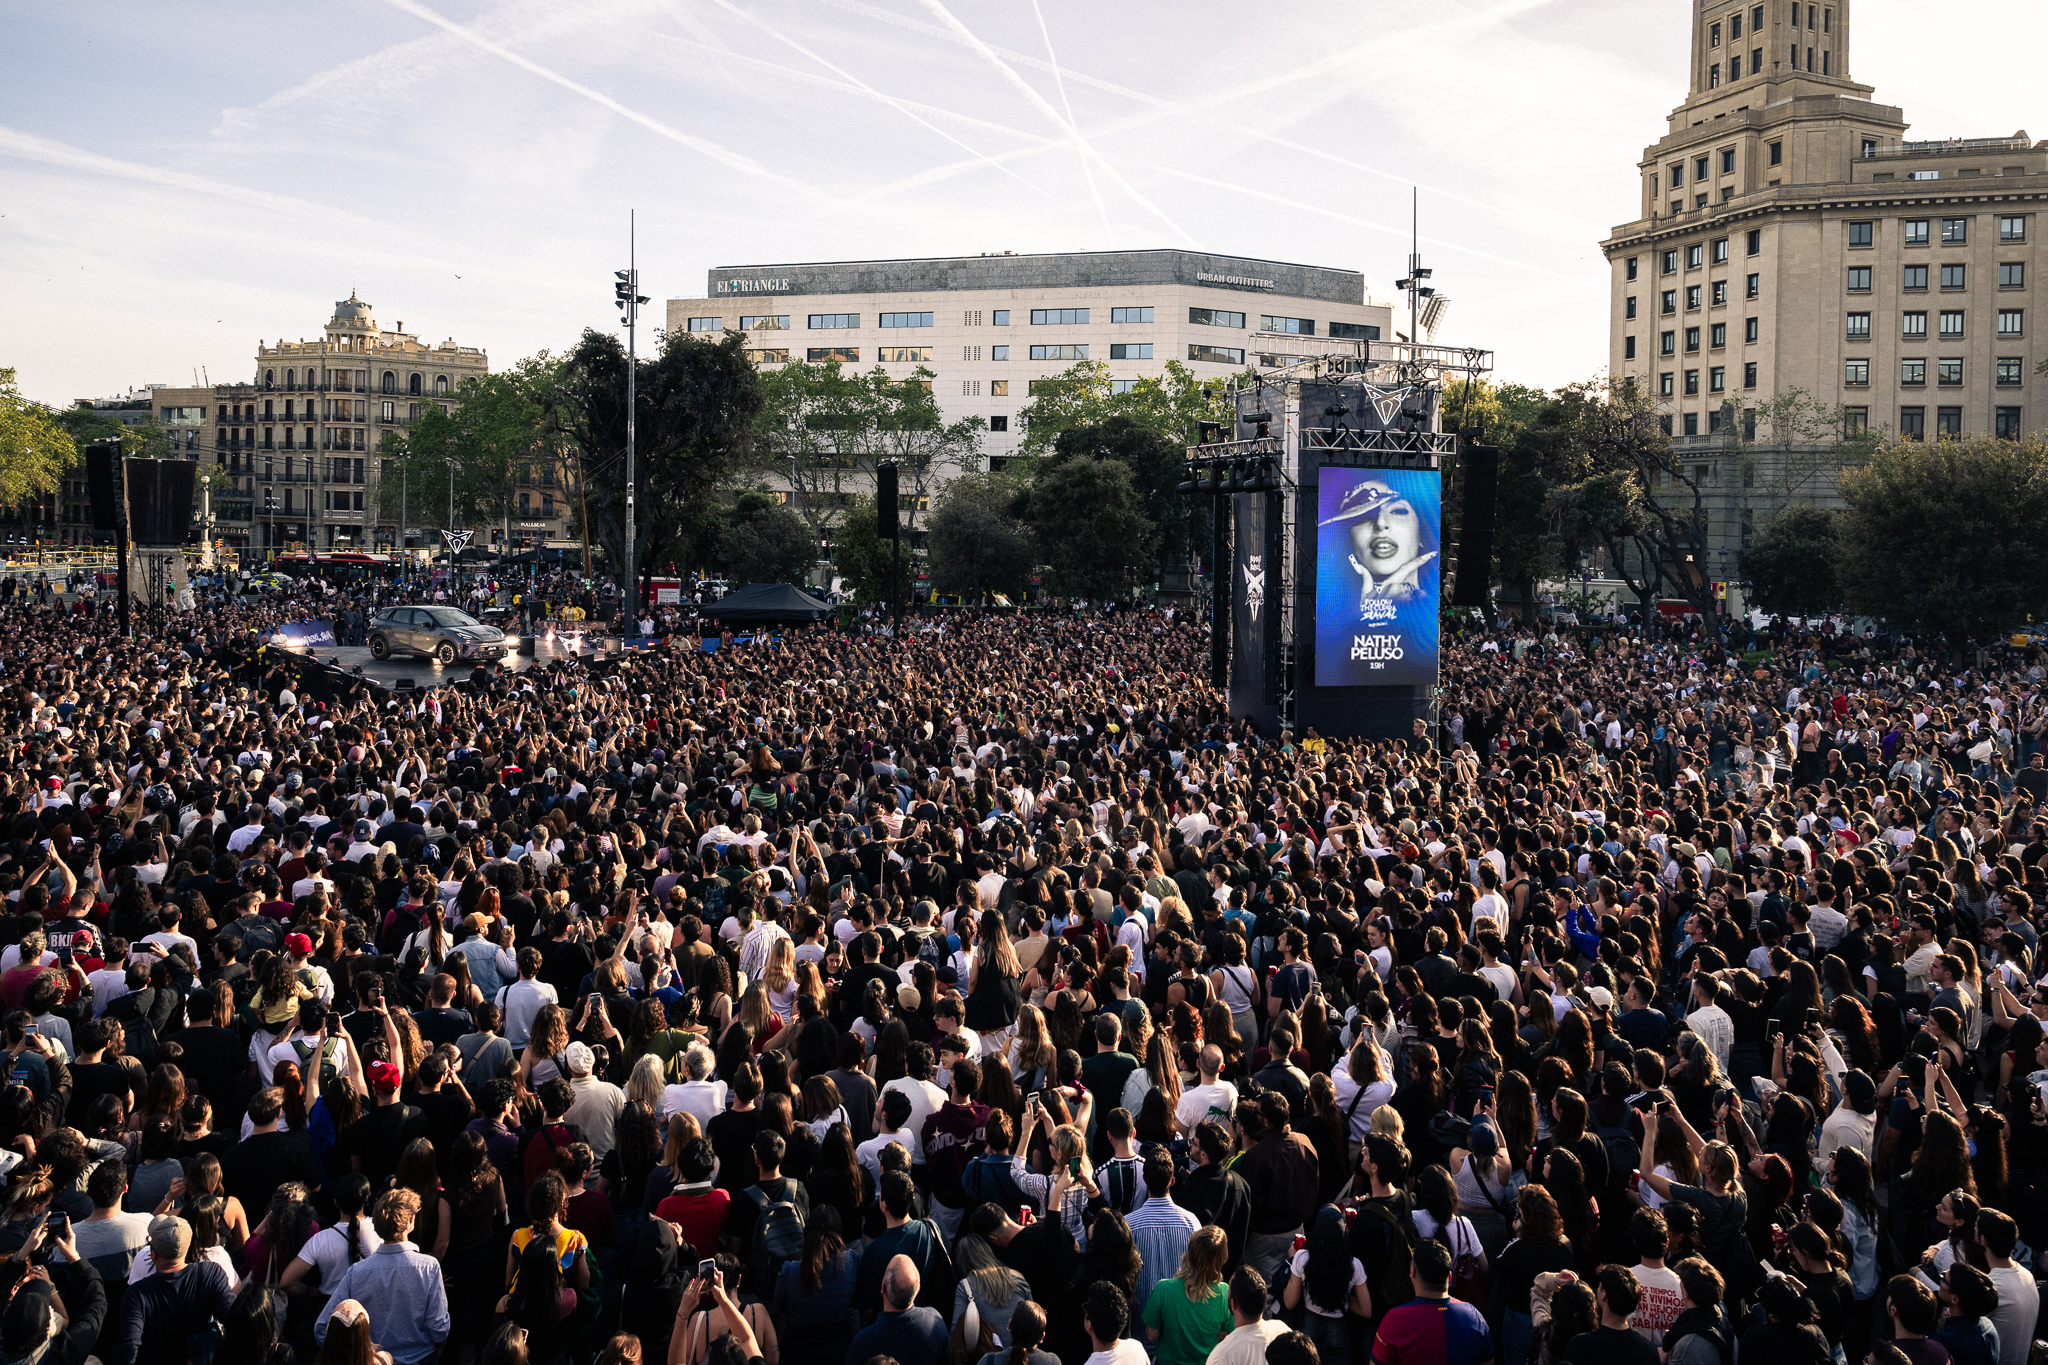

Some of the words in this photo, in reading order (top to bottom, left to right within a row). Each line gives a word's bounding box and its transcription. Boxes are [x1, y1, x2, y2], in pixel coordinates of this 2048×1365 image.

[717, 280, 731, 292] EL
[730, 278, 789, 292] TRIANGLE
[1197, 272, 1225, 283] URBAN
[1226, 275, 1274, 288] OUTFITTERS
[1354, 635, 1401, 647] NATHY
[1351, 646, 1404, 660] PELUSO
[1650, 1287, 1677, 1298] TIEMPOS
[1636, 1303, 1649, 1312] AN
[1649, 1294, 1685, 1308] VIVIMOS
[1642, 1311, 1647, 1319] Y
[1649, 1312, 1660, 1320] NO
[1663, 1313, 1674, 1322] LO
